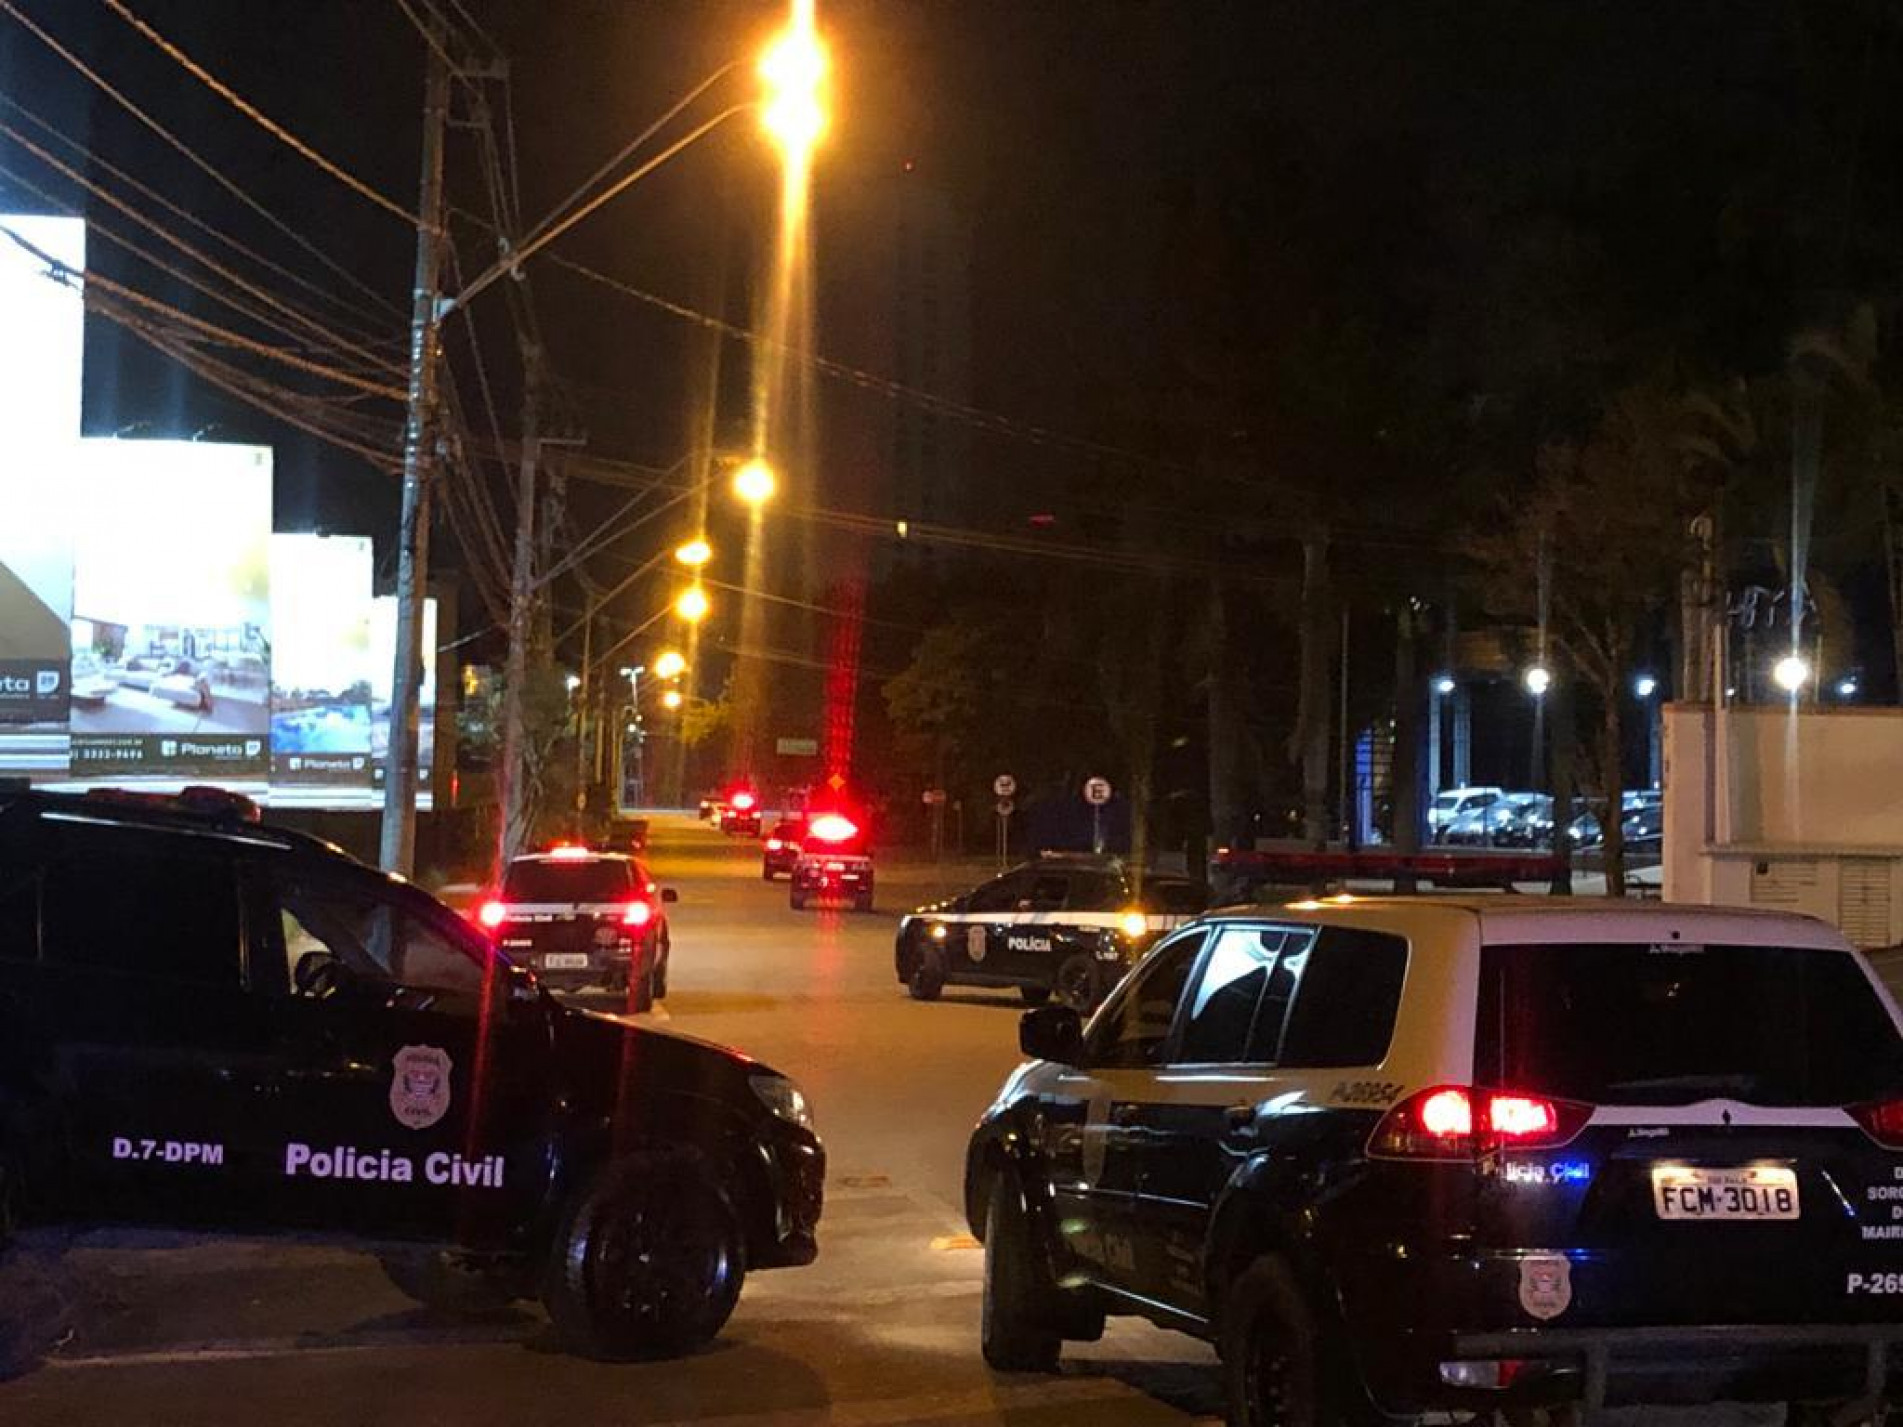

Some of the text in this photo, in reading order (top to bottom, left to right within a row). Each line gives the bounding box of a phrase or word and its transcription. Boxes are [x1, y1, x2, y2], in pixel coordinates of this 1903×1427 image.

[0, 676, 30, 691] ta
[181, 743, 242, 757] Planeta
[112, 1137, 224, 1165] D.7-DPM
[285, 1143, 505, 1188] Policia Civil
[1661, 1186, 1793, 1213] FCM-3018
[1847, 1273, 1903, 1294] P-26
